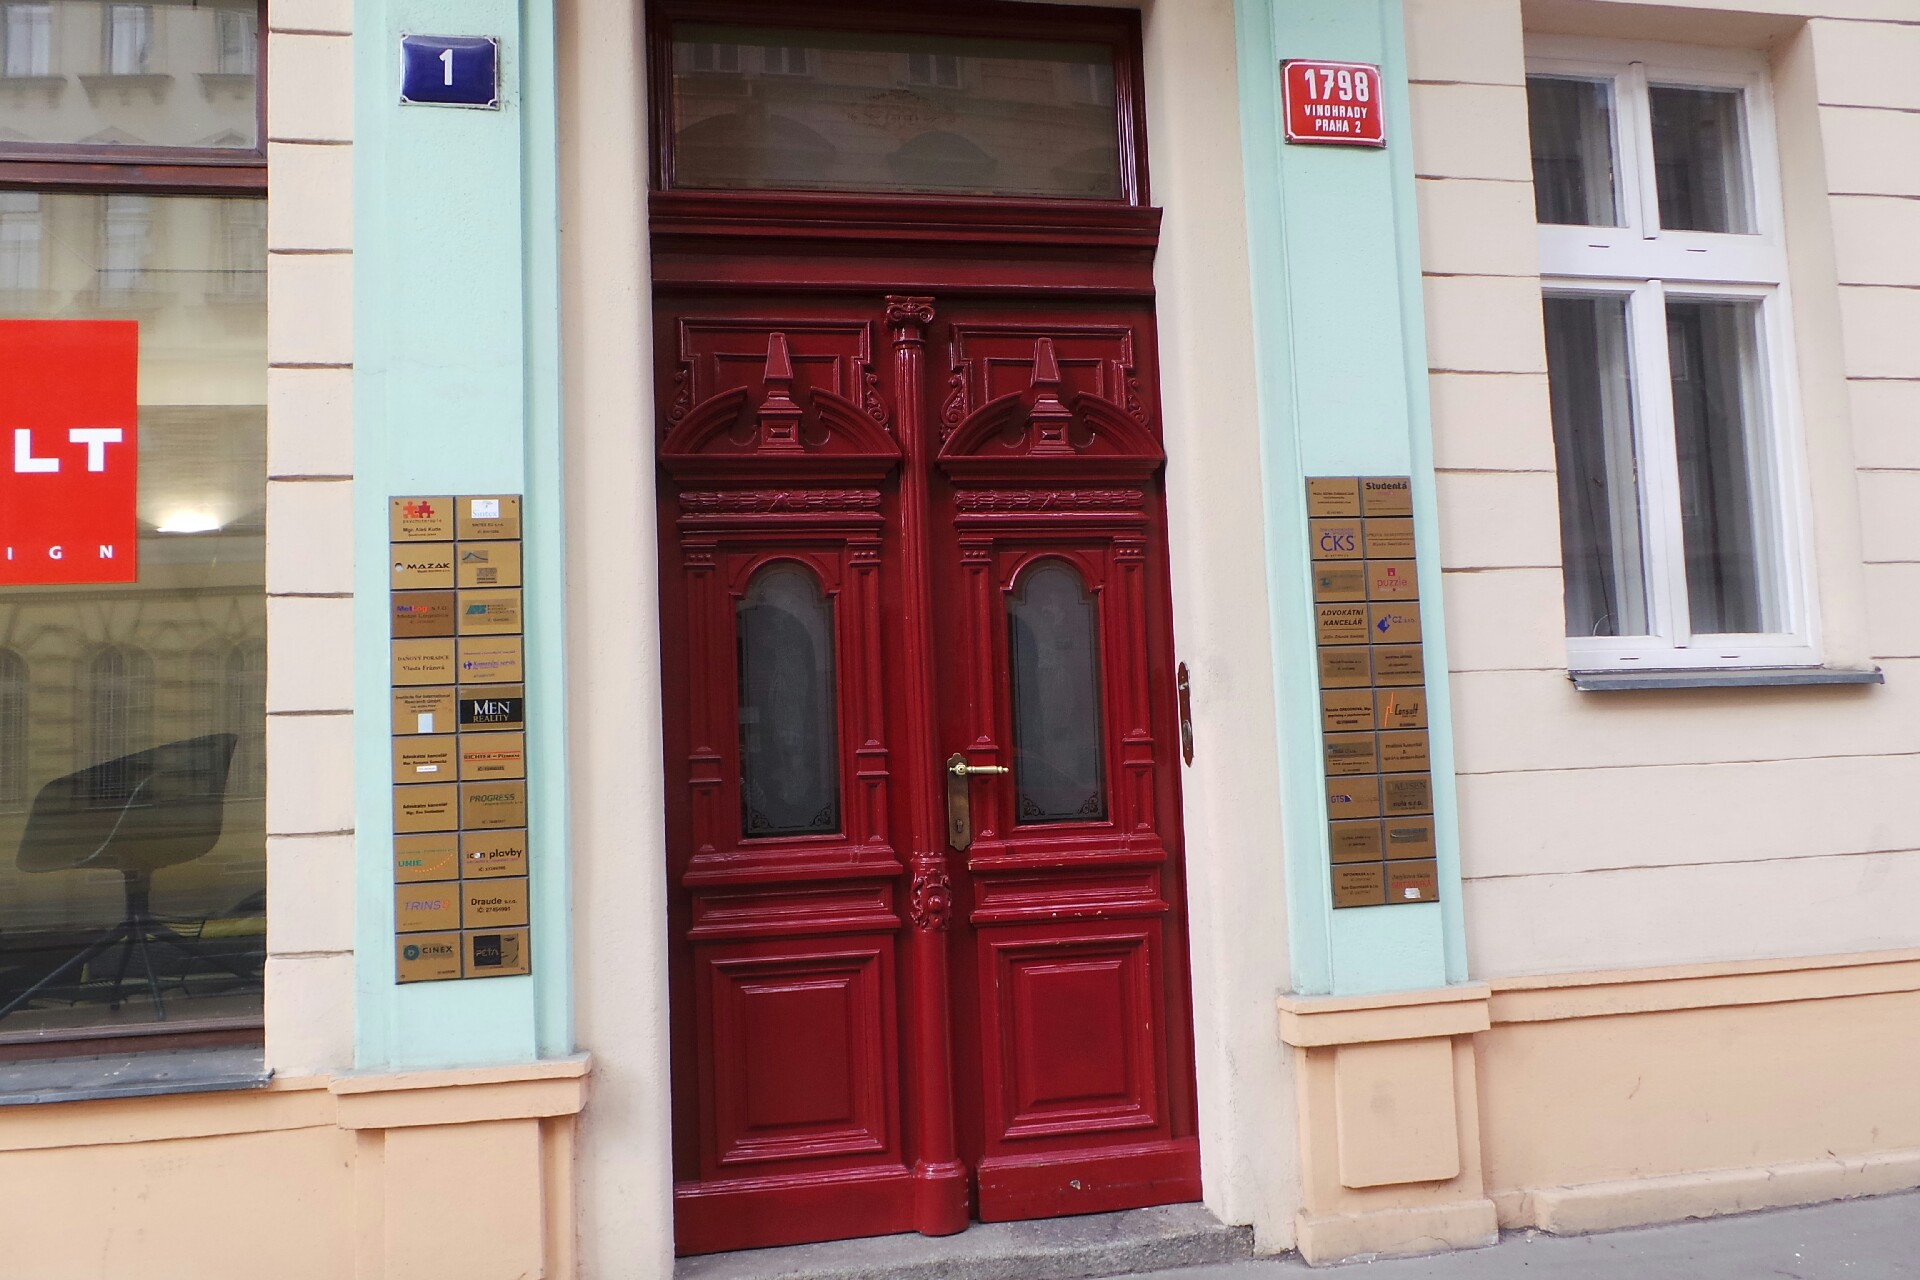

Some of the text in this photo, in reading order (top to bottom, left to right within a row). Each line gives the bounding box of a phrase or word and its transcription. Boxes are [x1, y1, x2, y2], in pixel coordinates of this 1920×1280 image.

[439, 48, 453, 86] 1
[1304, 68, 1369, 102] 1798
[1304, 104, 1367, 118] VINOHRADY
[1315, 119, 1361, 133] PRAHA 2
[1320, 532, 1354, 551] ČKS
[1377, 576, 1408, 588] puzzle
[1324, 618, 1362, 626] KANCELÁŘ
[1395, 704, 1418, 716] Consult
[473, 714, 508, 722] REALITY
[470, 794, 514, 802] PROGRESS
[1331, 795, 1344, 804] GTS
[490, 848, 522, 859] plavby
[471, 898, 502, 906] Draude
[422, 946, 452, 954] CINEX
